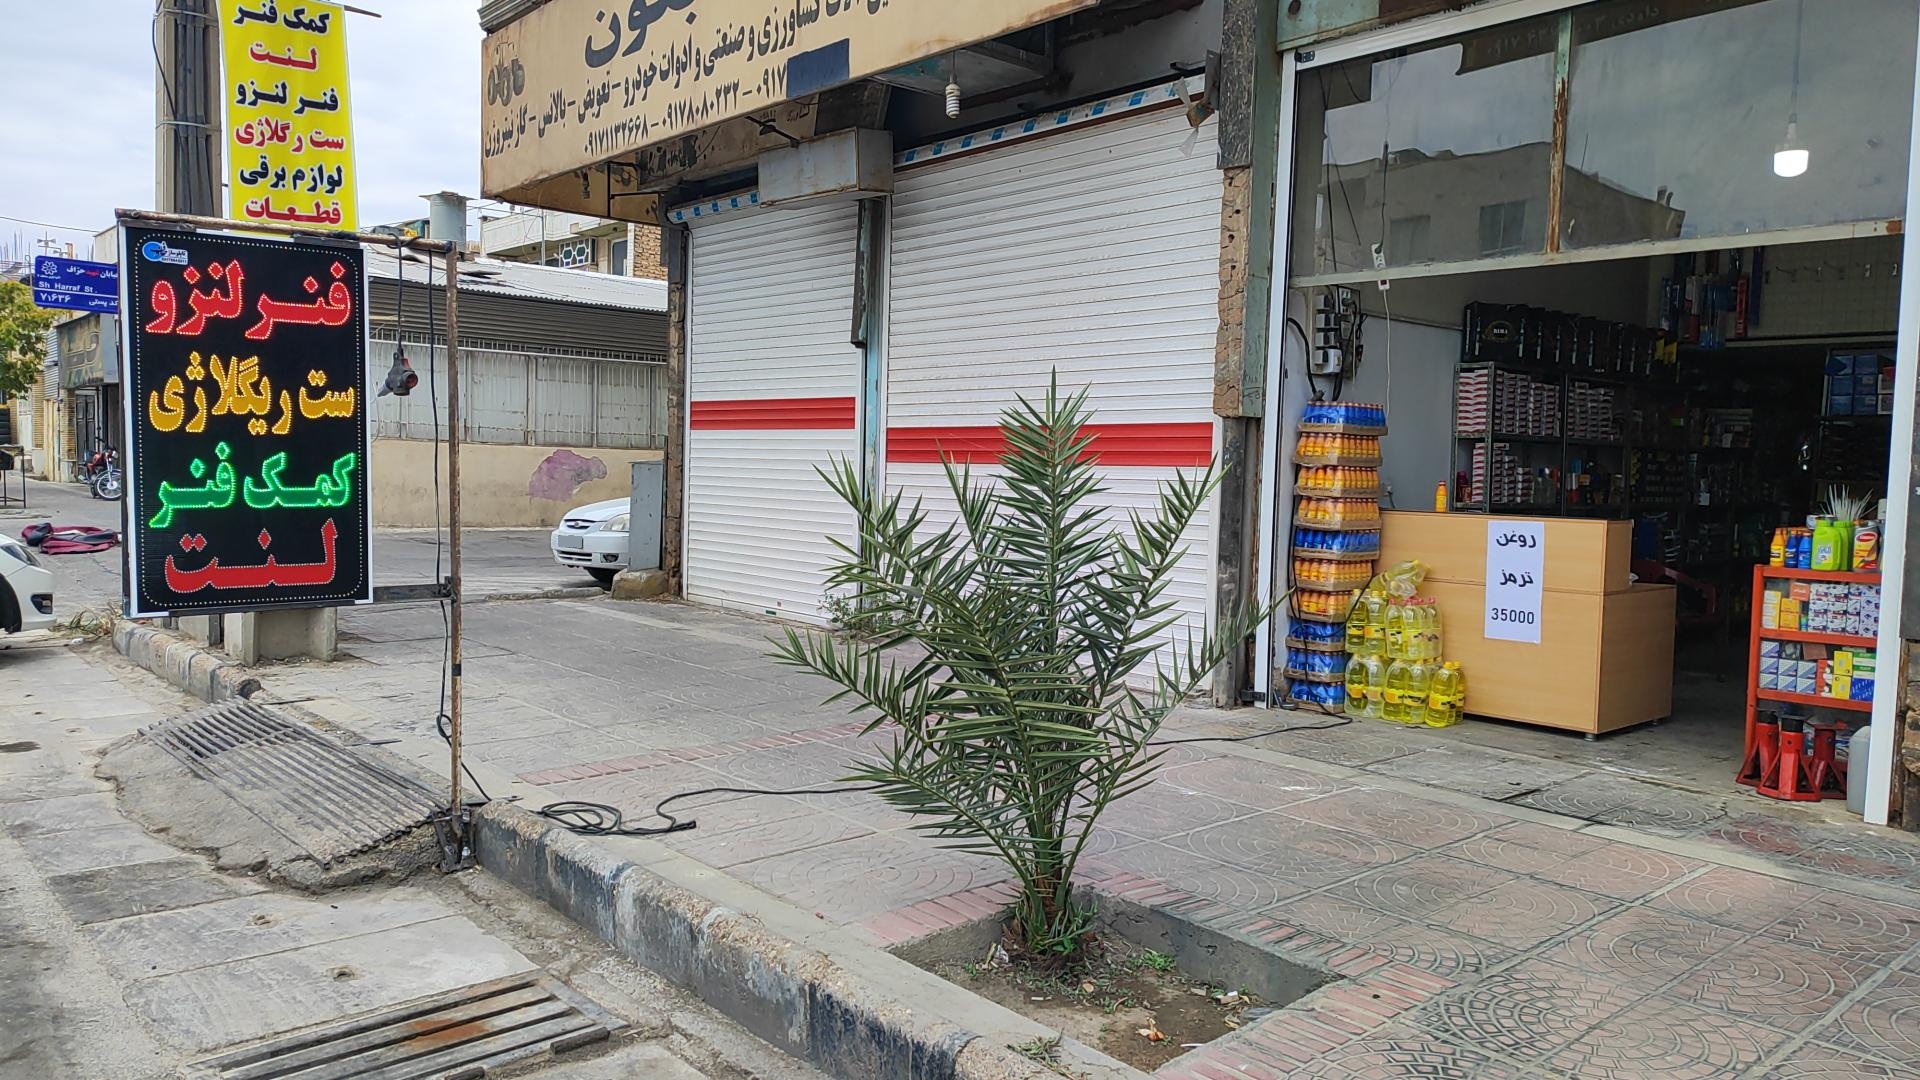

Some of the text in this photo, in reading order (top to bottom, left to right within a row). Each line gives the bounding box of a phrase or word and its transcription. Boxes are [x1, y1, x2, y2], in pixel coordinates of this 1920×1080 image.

[233, 0, 330, 33] کمک فنر
[249, 42, 317, 70] لنت
[659, 33, 692, 89] ادوات
[703, 22, 745, 77] صنعتی
[747, 24, 755, 62] و
[623, 50, 658, 108] خودرو
[693, 47, 700, 82] و
[235, 80, 339, 115] فنر لنزو
[538, 88, 566, 138] بالانس
[578, 70, 610, 124] تعویض
[662, 78, 740, 130] ۰۹۱۷۸۰۸۰۲۳۲
[309, 130, 345, 150] ست
[484, 110, 514, 158] نیتروژن
[514, 104, 528, 148] گاز
[583, 114, 649, 158] ۰۹۱۷۱۱۳۲۶۶۸
[239, 155, 343, 194] لوازم برقی
[245, 196, 341, 224] قطعات
[38, 281, 50, 289] Sh
[54, 282, 81, 292] Harraf
[40, 292, 71, 303] ۷۱۶۳۶
[88, 299, 108, 307] پستی
[145, 259, 351, 339] فنر لنزو
[149, 351, 355, 435] ست ریگلاژی
[148, 441, 357, 529] کمک فنر
[164, 517, 339, 593] لنت
[1495, 530, 1537, 549] روغن
[1499, 569, 1534, 588] ترمز
[1491, 607, 1535, 625] 35000
